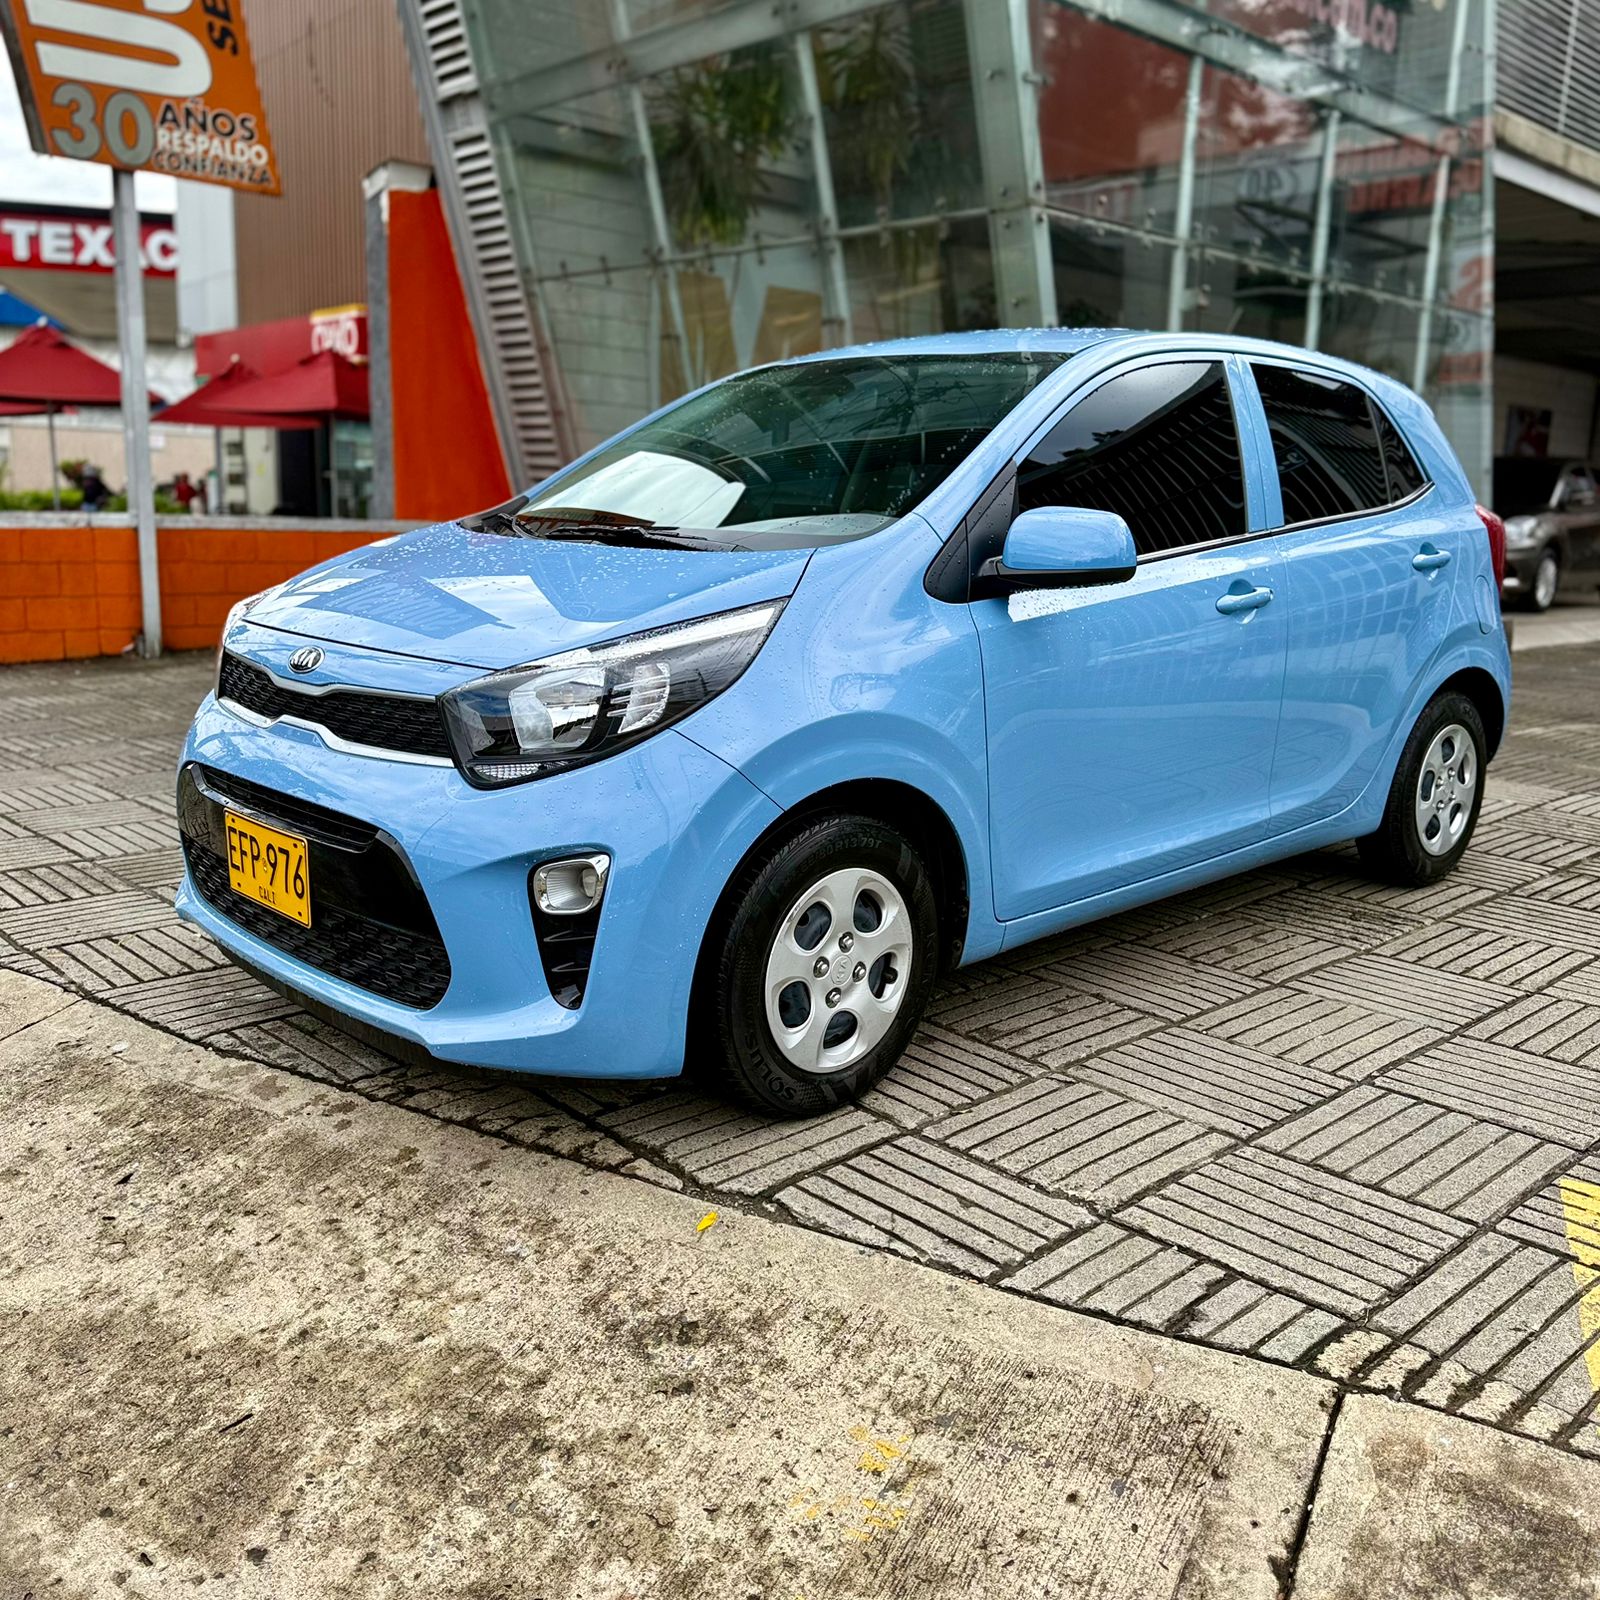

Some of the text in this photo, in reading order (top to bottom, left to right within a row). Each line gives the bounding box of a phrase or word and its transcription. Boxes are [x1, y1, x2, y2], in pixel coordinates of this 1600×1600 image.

[51, 82, 256, 166] 30 AÑOS
[156, 129, 269, 166] RESPALDO
[154, 150, 273, 186] CONFIANZA
[1, 217, 178, 272] TEXC
[258, 885, 276, 905] CALI
